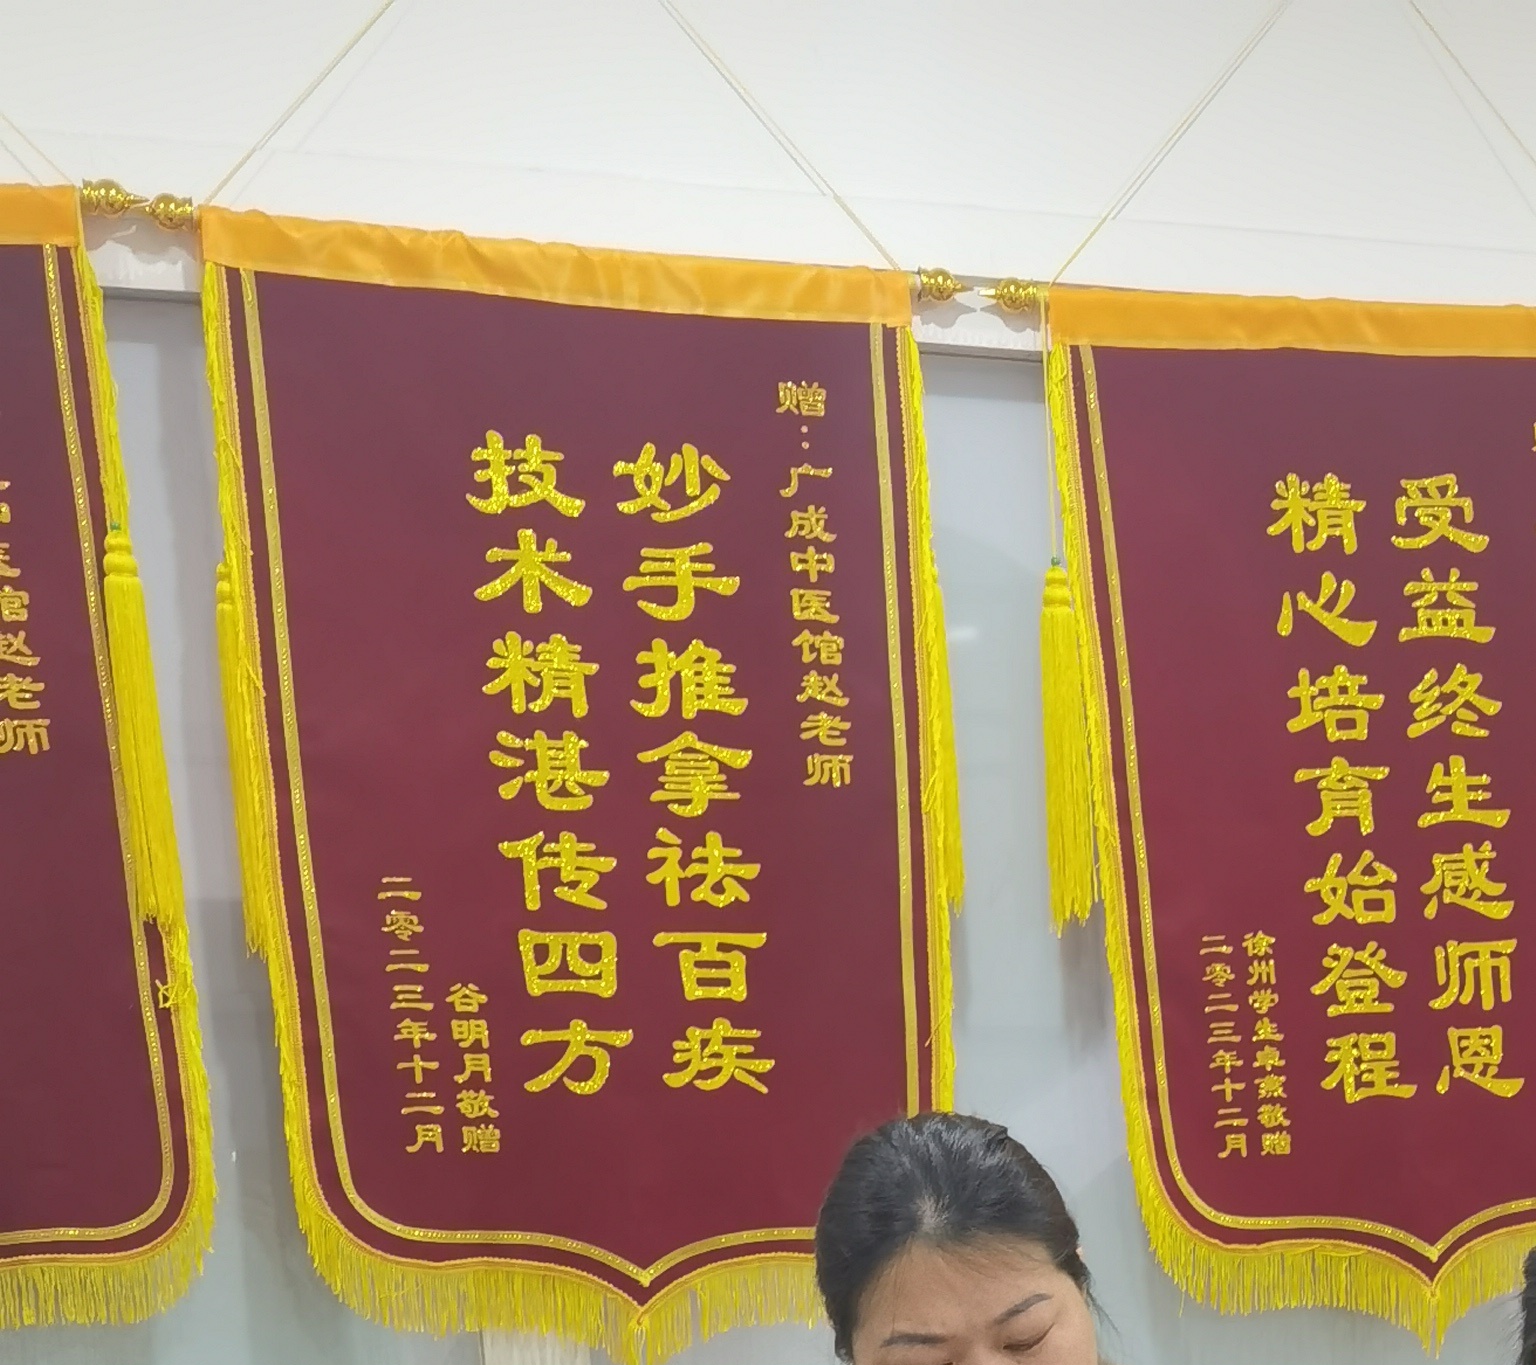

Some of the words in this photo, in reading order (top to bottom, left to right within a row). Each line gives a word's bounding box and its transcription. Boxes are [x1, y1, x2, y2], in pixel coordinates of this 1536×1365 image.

[377, 876, 445, 1153] 二零二三年十二月
[445, 982, 501, 1153] 谷明月敬赠
[465, 429, 634, 1095] 技术精湛传四方
[612, 441, 776, 1095] 妙手推拿祛百疾
[1199, 935, 1249, 1159] 二零二三年十二月
[1266, 471, 1418, 1104] 精心培育始登程
[1390, 472, 1525, 1098] 受益终生感师恩
